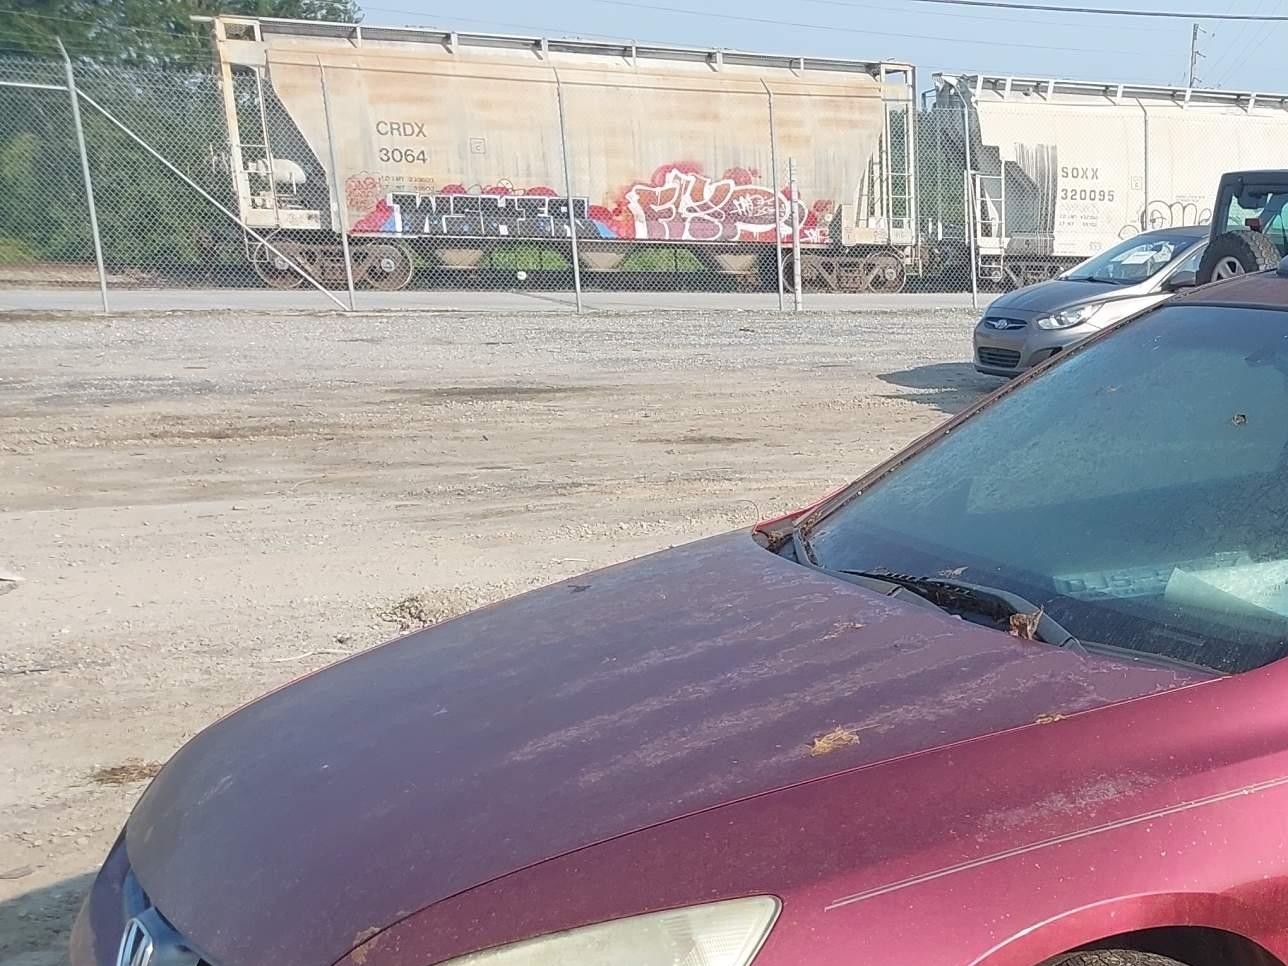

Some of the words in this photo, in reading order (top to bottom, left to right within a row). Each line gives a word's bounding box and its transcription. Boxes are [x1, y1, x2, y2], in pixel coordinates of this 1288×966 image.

[375, 120, 427, 138] CRDX
[379, 147, 428, 164] 3064
[1060, 166, 1100, 181] SOXX
[1060, 188, 1116, 202] 320095
